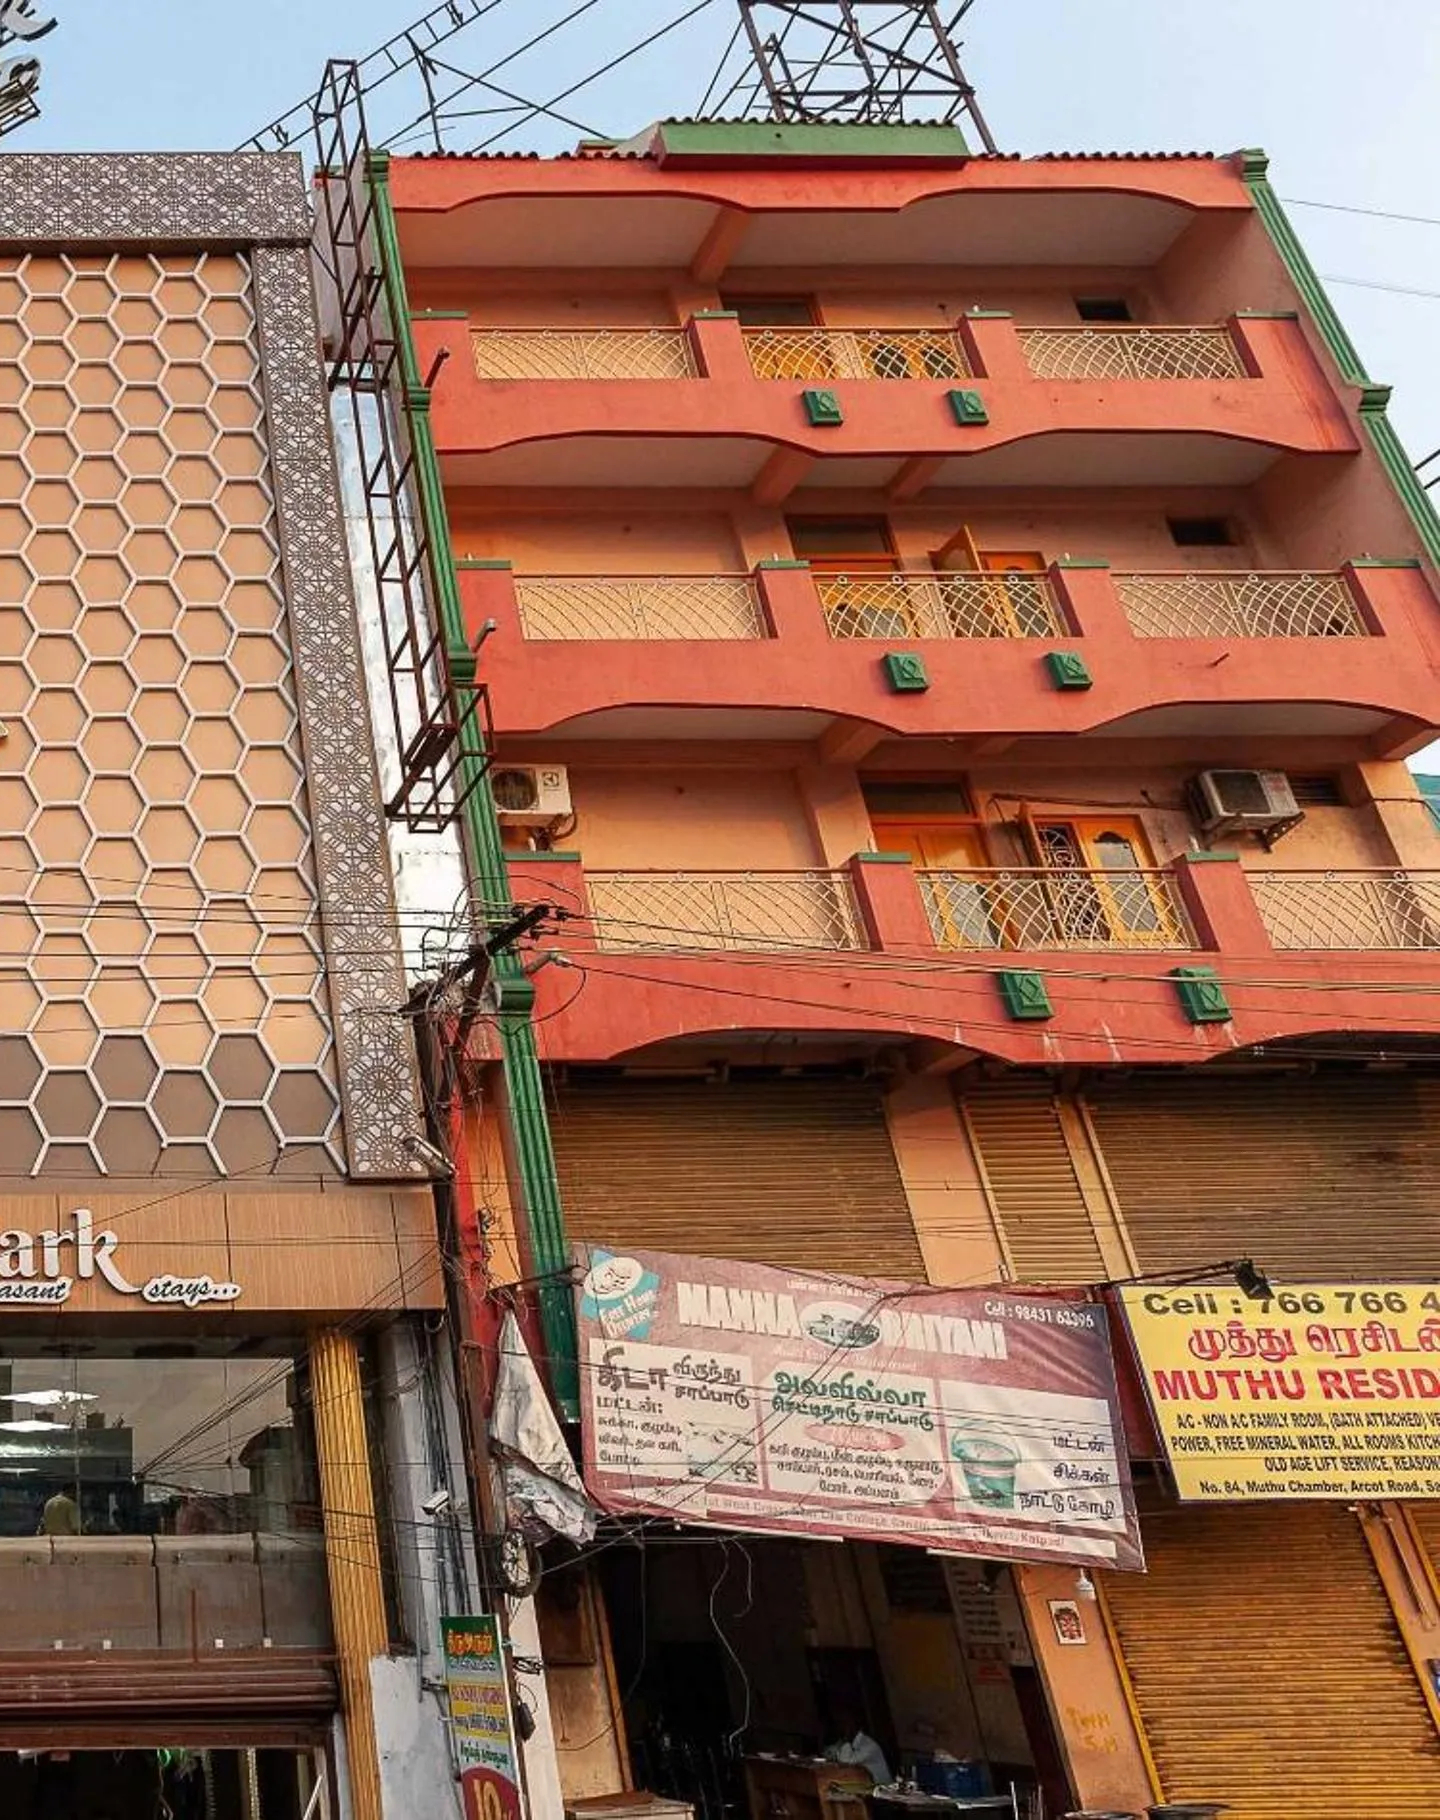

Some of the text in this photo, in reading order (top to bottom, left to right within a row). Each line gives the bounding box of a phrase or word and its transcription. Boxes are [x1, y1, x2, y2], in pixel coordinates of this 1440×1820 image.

[984, 1301, 1005, 1316] Cell
[1143, 1293, 1217, 1315] Cell
[1334, 1291, 1407, 1314] 766
[1188, 1320, 1299, 1362] முத்து
[1153, 1368, 1306, 1400] MUTHU
[675, 1385, 750, 1409] சாப்பாடு
[1202, 1413, 1229, 1429] NON
[1249, 1413, 1289, 1428] FAMILY
[1216, 1435, 1245, 1450] FREE
[1246, 1435, 1297, 1450] MINERAL
[1342, 1435, 1363, 1449] ALL
[1364, 1435, 1405, 1450] ROOMS
[1053, 1462, 1111, 1484] சிக்கன்
[1264, 1456, 1287, 1471] OLD
[1290, 1456, 1313, 1471] AGE
[1315, 1456, 1338, 1471] LIFT
[1246, 1480, 1286, 1493] Muthu
[1351, 1480, 1385, 1493] Arcot
